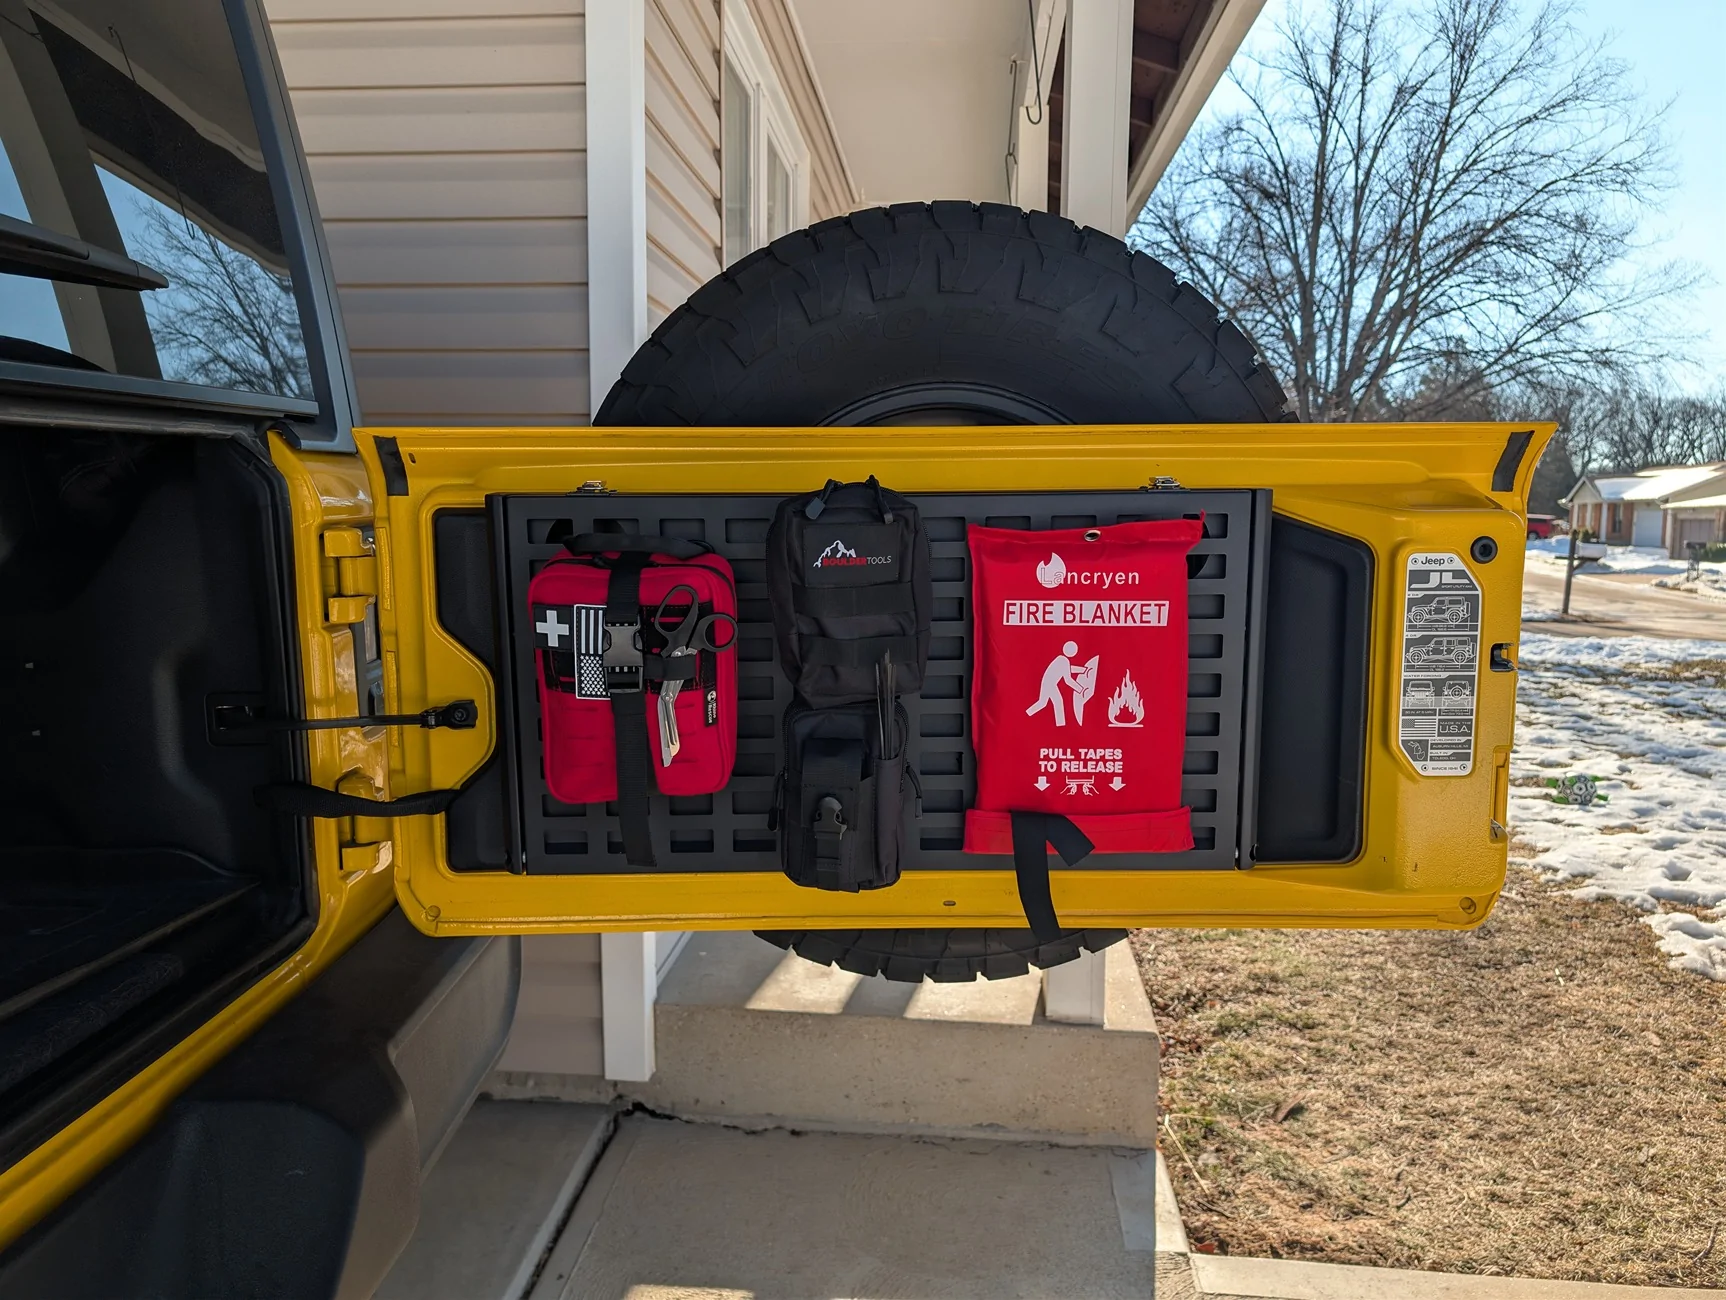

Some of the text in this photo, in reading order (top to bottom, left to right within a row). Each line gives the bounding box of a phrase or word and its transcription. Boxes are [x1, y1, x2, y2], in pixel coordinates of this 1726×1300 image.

[1421, 556, 1446, 567] Jeep
[1041, 567, 1140, 589] Lancryen
[1006, 603, 1167, 625] FIRE BLANKET
[1439, 725, 1471, 733] U.S.A.
[1040, 748, 1123, 760] PULL TAPES
[1038, 760, 1124, 773] TO RELEASE
